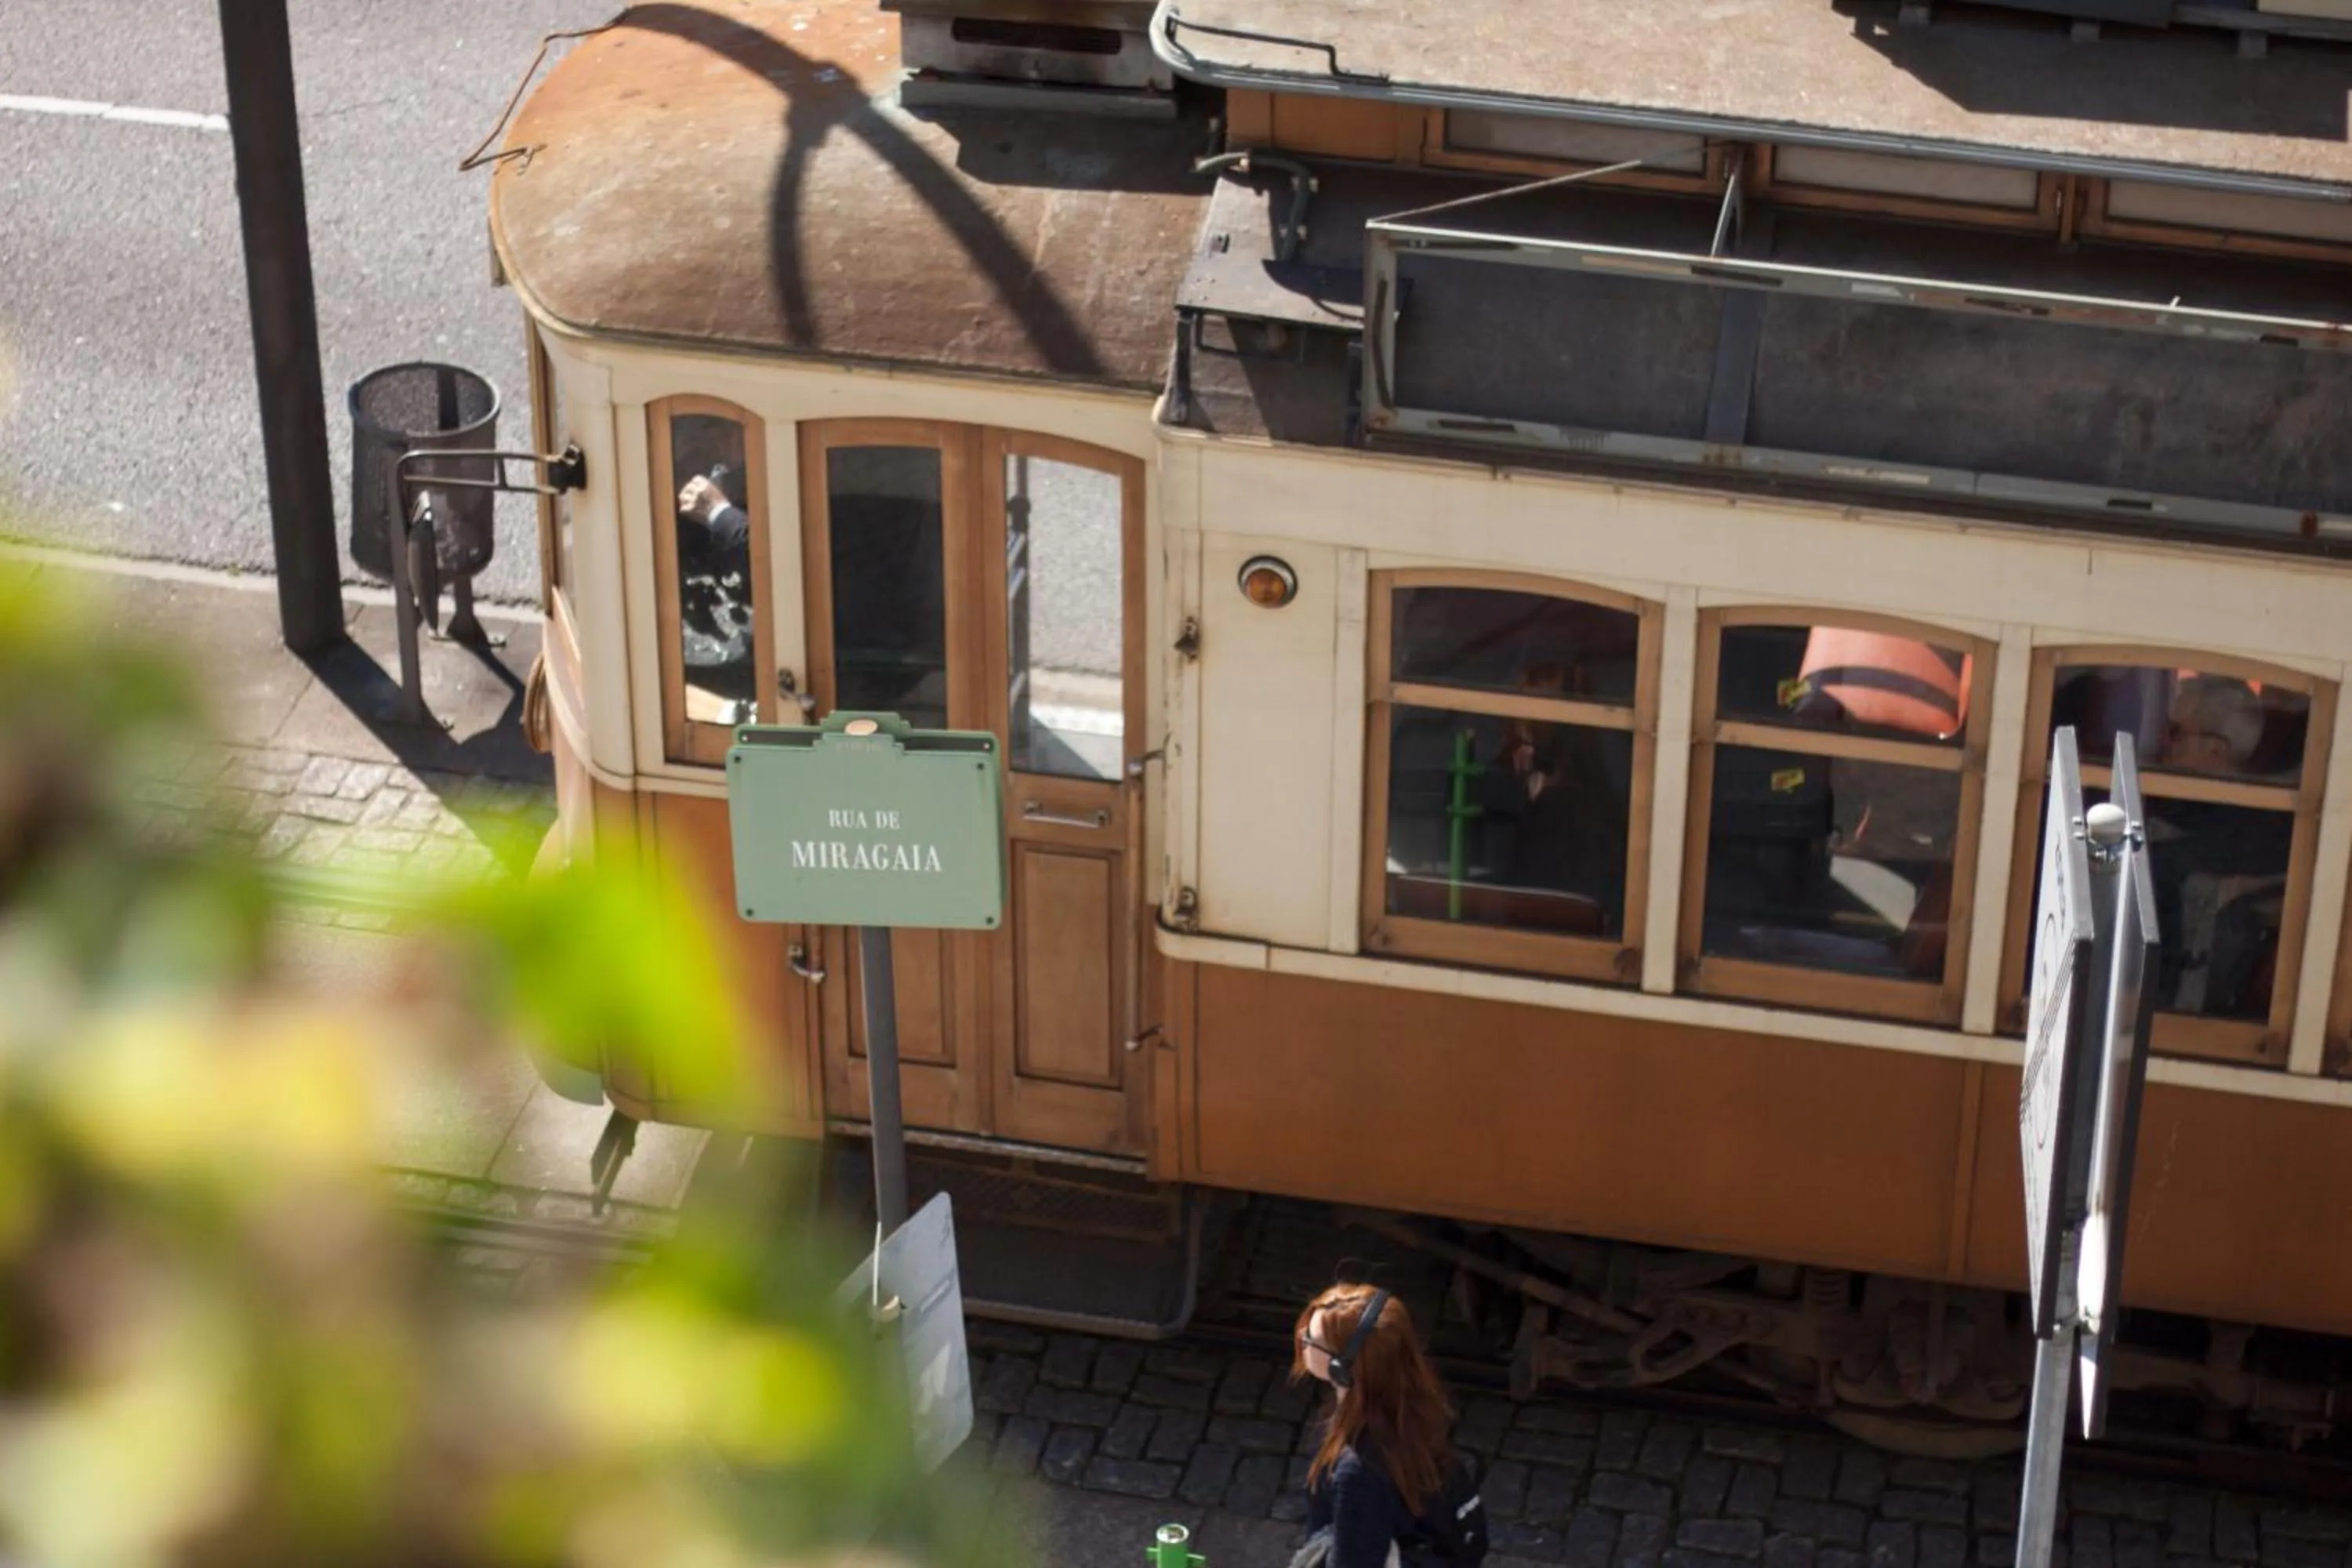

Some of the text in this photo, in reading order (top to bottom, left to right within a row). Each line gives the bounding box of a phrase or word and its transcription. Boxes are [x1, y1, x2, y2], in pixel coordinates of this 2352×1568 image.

[829, 809, 900, 829] RUA DE
[792, 840, 942, 872] MIRAGAIA
